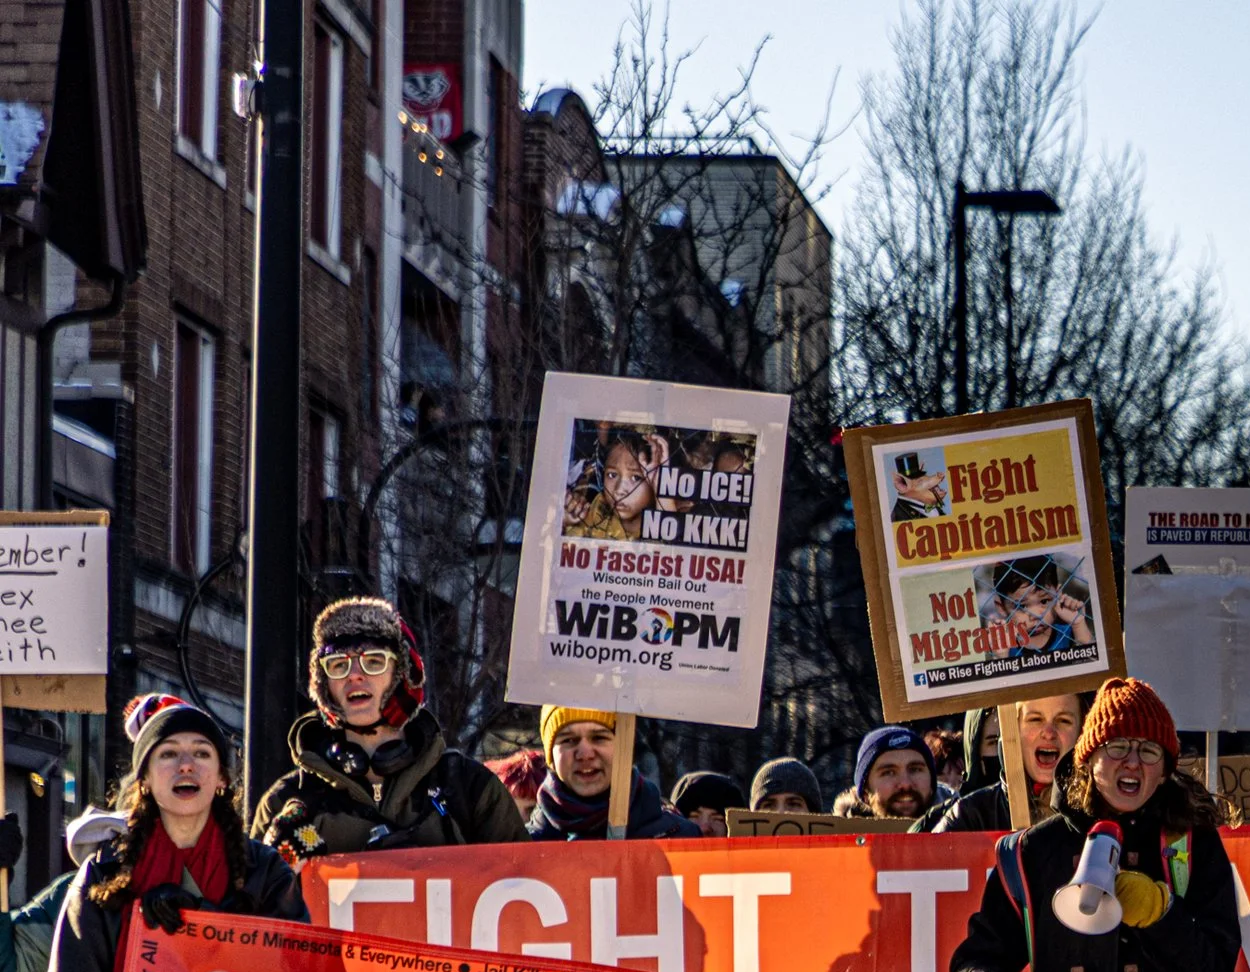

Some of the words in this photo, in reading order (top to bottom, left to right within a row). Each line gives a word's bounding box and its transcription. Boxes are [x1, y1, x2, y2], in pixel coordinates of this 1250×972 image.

[659, 466, 695, 498] No
[699, 471, 751, 503] ICE!
[948, 454, 1039, 504] Fight
[643, 511, 677, 541] No
[684, 516, 747, 548] KKK!
[896, 503, 1079, 560] Capitalism
[1148, 530, 1157, 541] IS
[1160, 530, 1191, 542] PAVED
[1195, 530, 1207, 542] BY
[1149, 512, 1176, 528] THE
[1180, 512, 1219, 528] ROAD
[1223, 513, 1241, 528] TO
[560, 543, 590, 570] No
[595, 547, 684, 578] Fascist
[688, 554, 745, 585] USA!
[581, 588, 601, 600] the
[604, 590, 646, 605] People
[649, 594, 714, 611] Movement
[593, 572, 654, 588] Wisconsin
[657, 577, 681, 591] Bail
[684, 580, 707, 593] Out
[928, 587, 977, 623] Not
[0, 637, 56, 662] ith
[550, 640, 673, 670] wibopm.org
[910, 619, 1032, 664] Migrants
[928, 667, 947, 682] We
[949, 664, 972, 680] Rise
[975, 658, 1020, 678] Fighting
[1021, 654, 1051, 668] Labor
[1054, 646, 1097, 663] Podcast
[142, 939, 158, 965] All
[202, 925, 234, 943] Out
[240, 930, 258, 945] of
[263, 932, 341, 957] Minnesota
[345, 944, 355, 959] &
[360, 947, 452, 972] Everywhere
